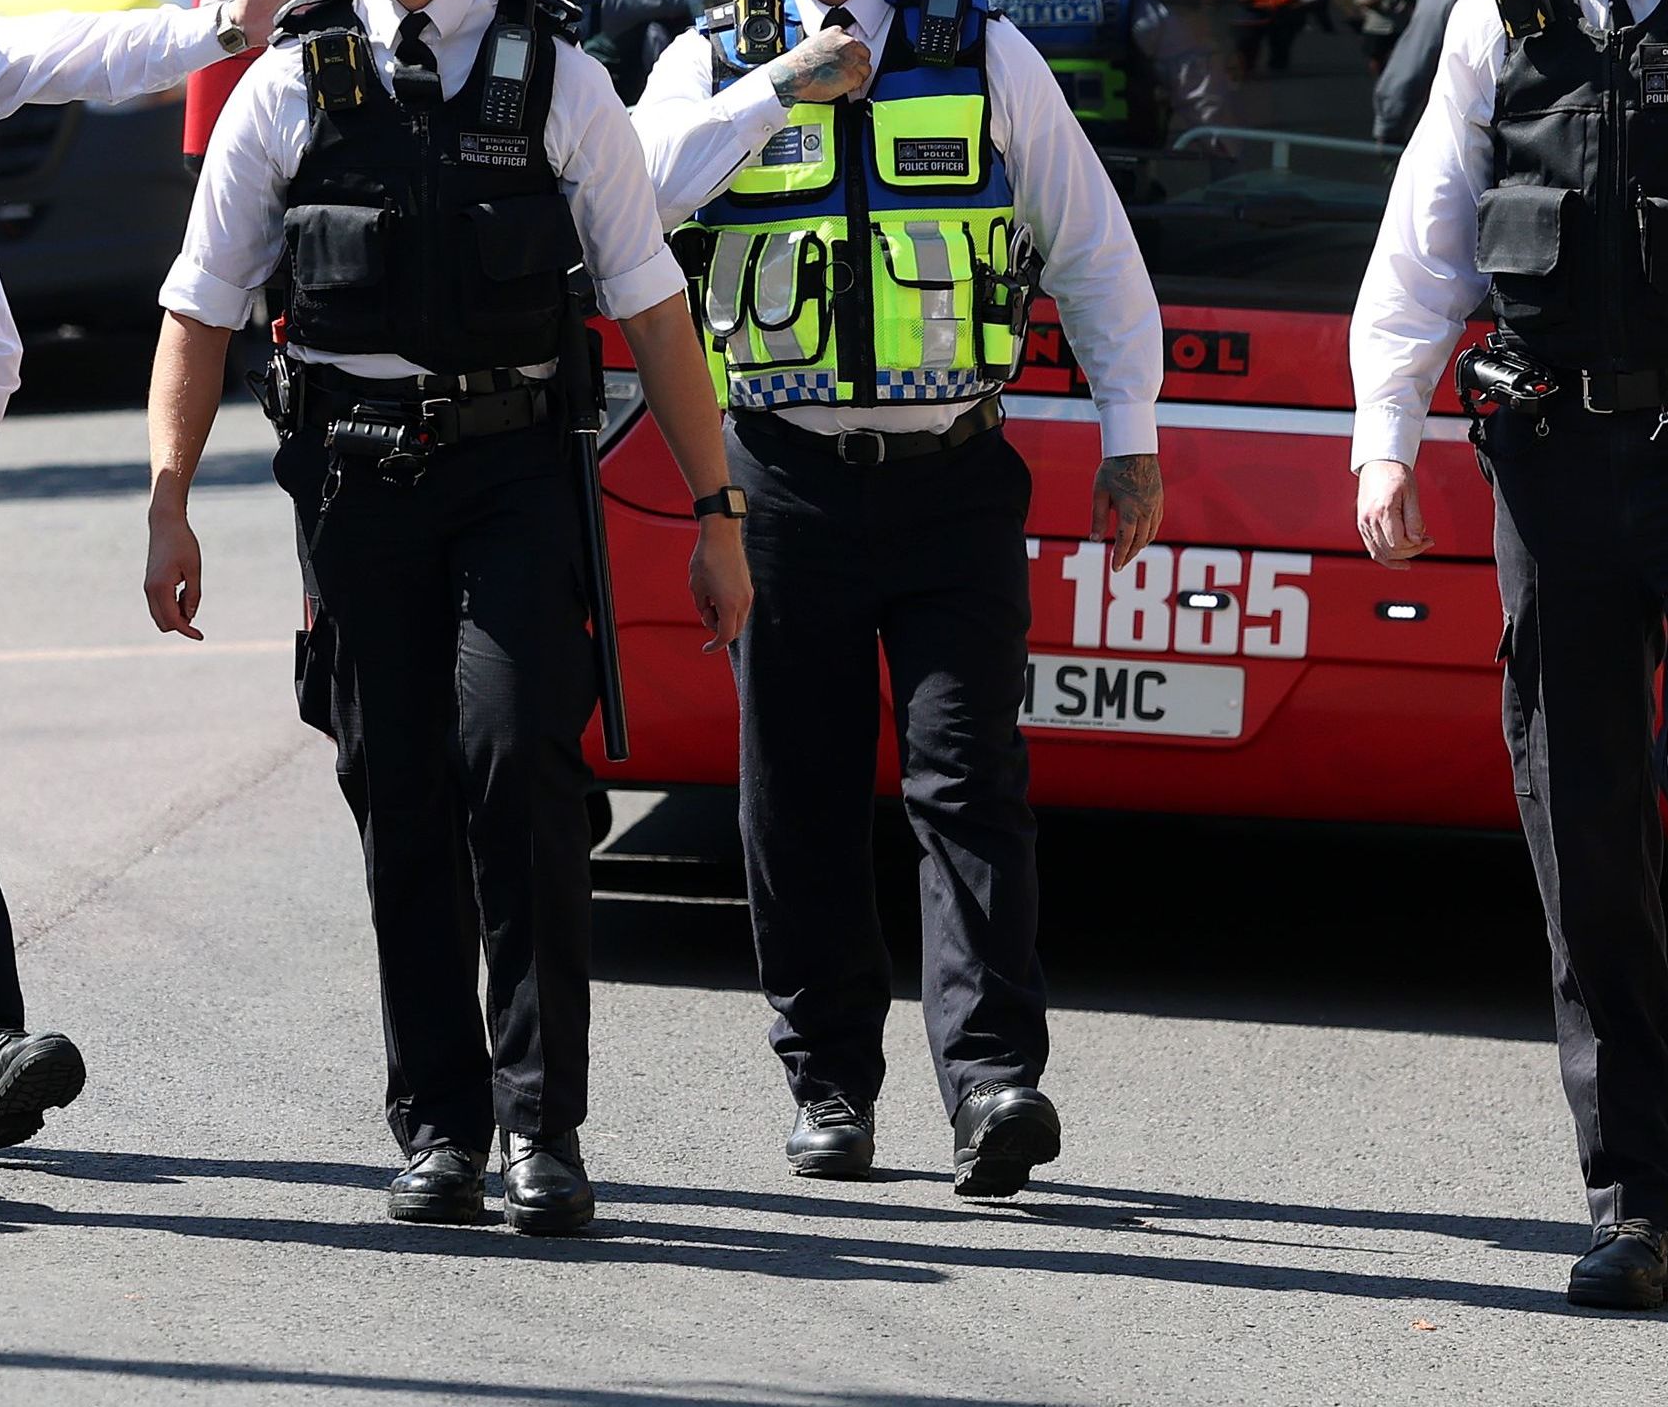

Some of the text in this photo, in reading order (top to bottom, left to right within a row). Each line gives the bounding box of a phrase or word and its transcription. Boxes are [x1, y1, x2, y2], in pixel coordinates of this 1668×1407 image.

[480, 136, 526, 145] METROPOLITAN
[485, 144, 520, 153] POLICE
[460, 152, 527, 166] POLICE OFFICER
[899, 162, 964, 171] POLICE OFFICER
[1062, 541, 1312, 659] 1865
[1055, 665, 1167, 721] SMC
